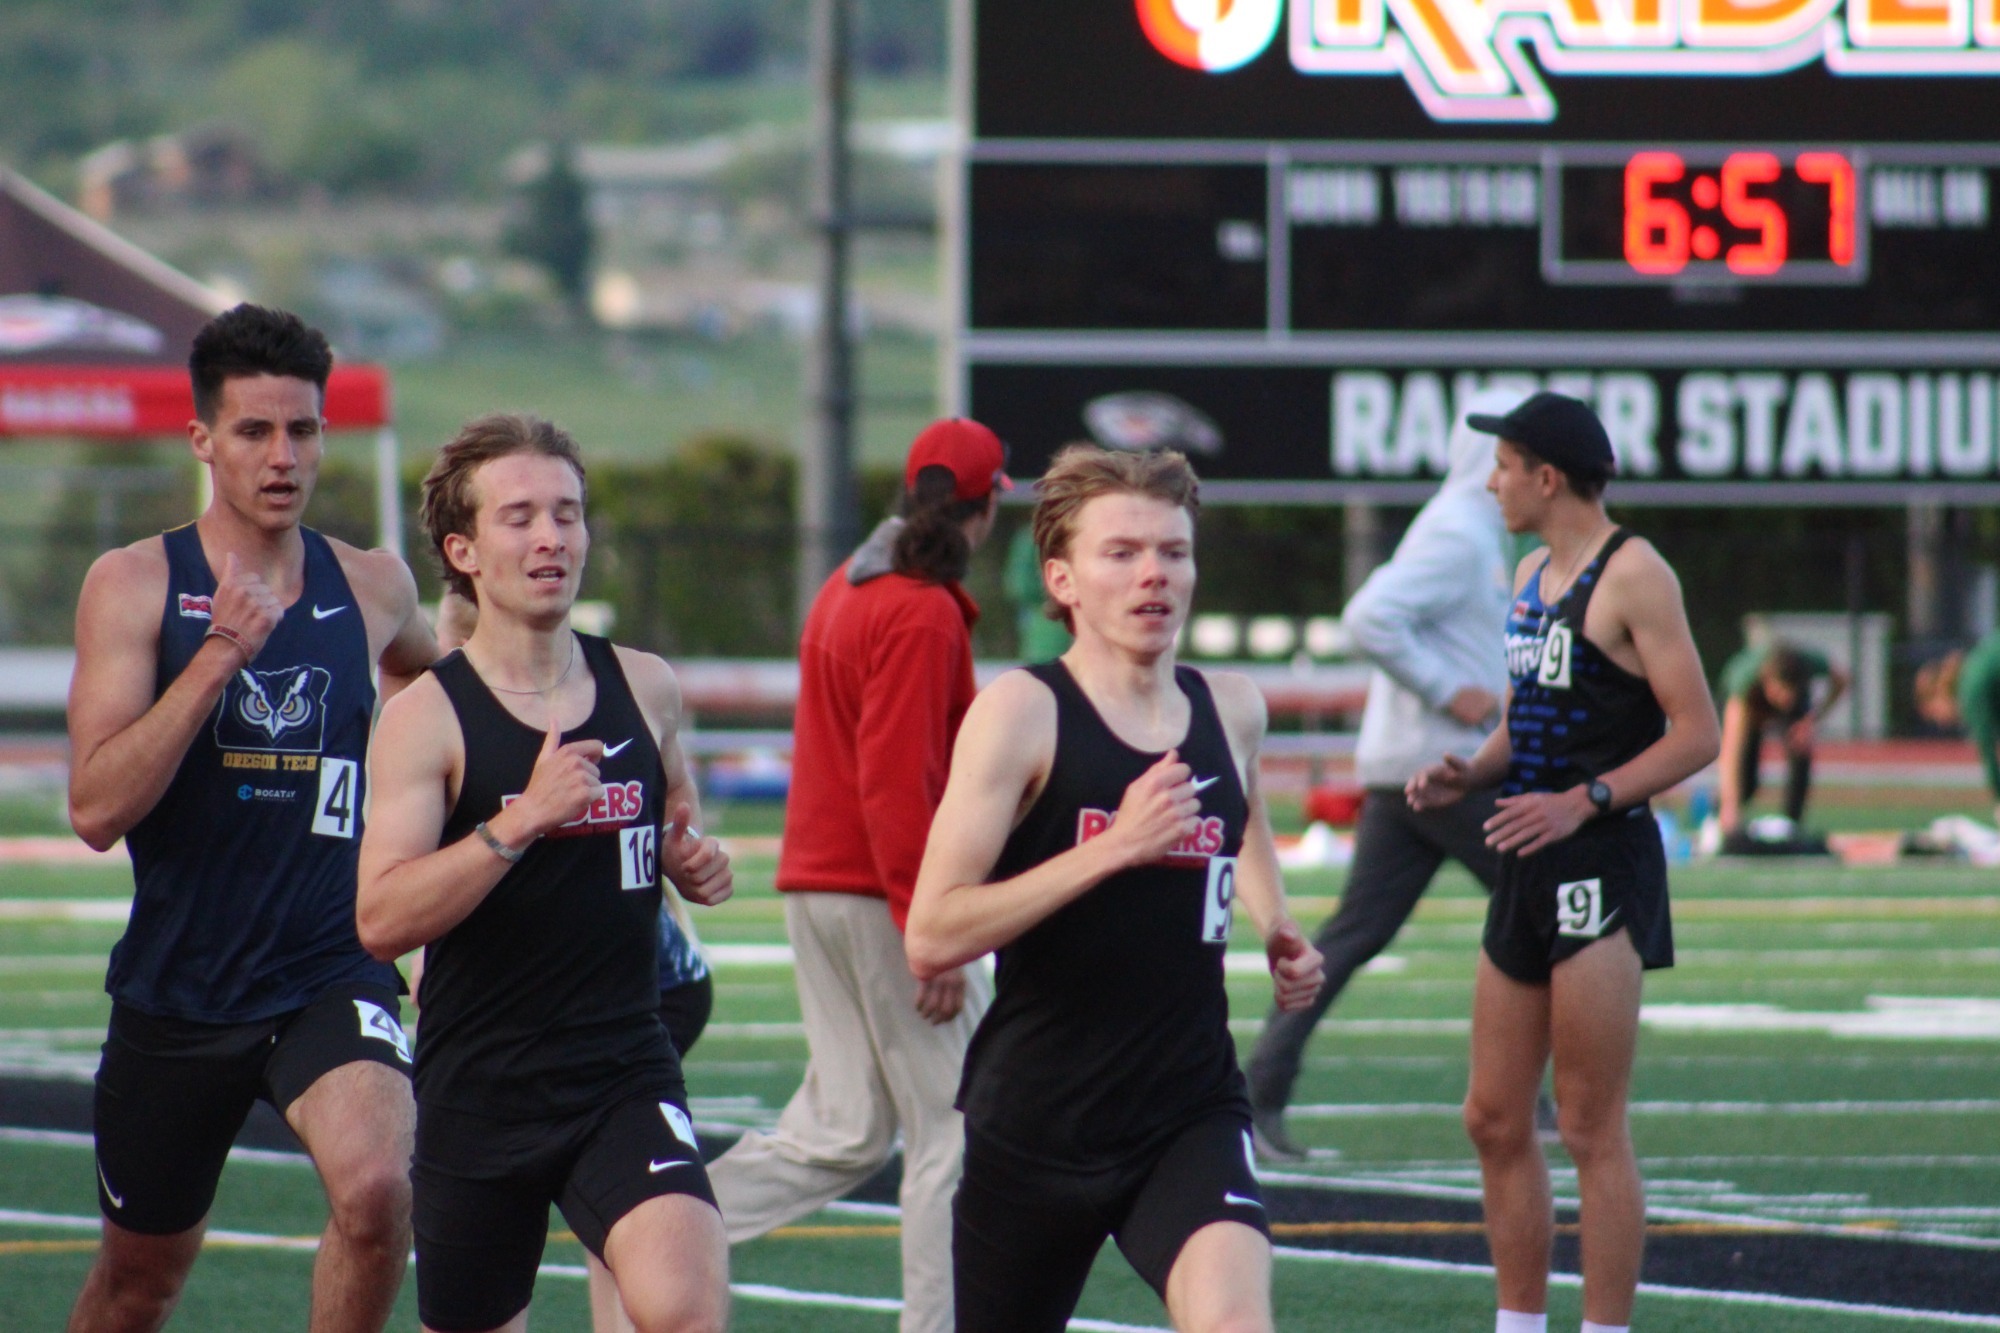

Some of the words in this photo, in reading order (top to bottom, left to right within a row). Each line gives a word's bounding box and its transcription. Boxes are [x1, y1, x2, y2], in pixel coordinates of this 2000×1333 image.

[1624, 152, 1855, 275] 6:57
[1332, 370, 1661, 475] RAR
[1675, 370, 2000, 477] STADIU
[1547, 632, 1564, 680] 9
[223, 753, 277, 770] OREGON
[282, 755, 318, 771] TECH
[324, 765, 350, 832] 4
[628, 829, 655, 885] 16
[1568, 883, 1591, 930] 9
[369, 1008, 399, 1047] 4
